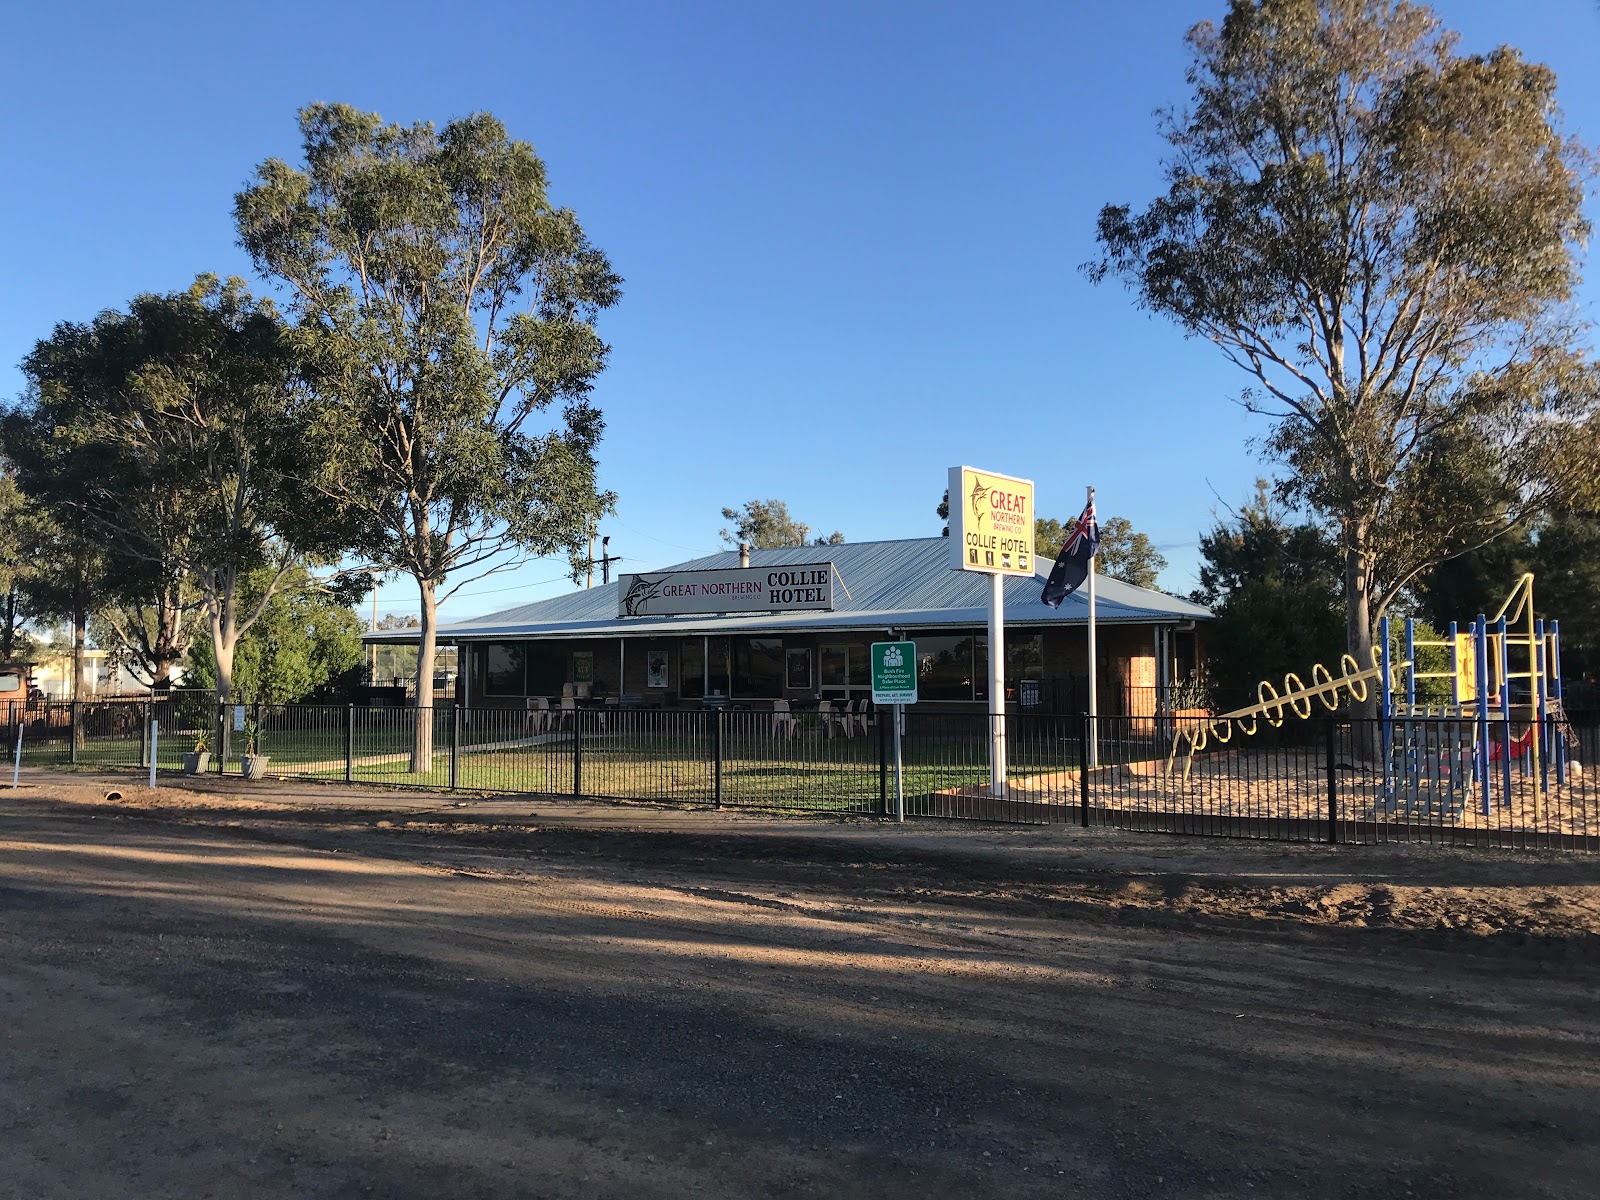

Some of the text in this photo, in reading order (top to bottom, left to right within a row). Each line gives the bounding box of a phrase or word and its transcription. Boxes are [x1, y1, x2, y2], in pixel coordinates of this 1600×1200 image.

[990, 490, 1026, 513] GREAT
[991, 511, 1025, 526] NORTHERN
[993, 523, 1013, 533] BREWING
[966, 532, 1030, 554] COLLIE HOTEL
[767, 570, 828, 587] COLLIE
[662, 581, 762, 597] GREAT NORTHERN
[769, 587, 826, 604] HOTEL
